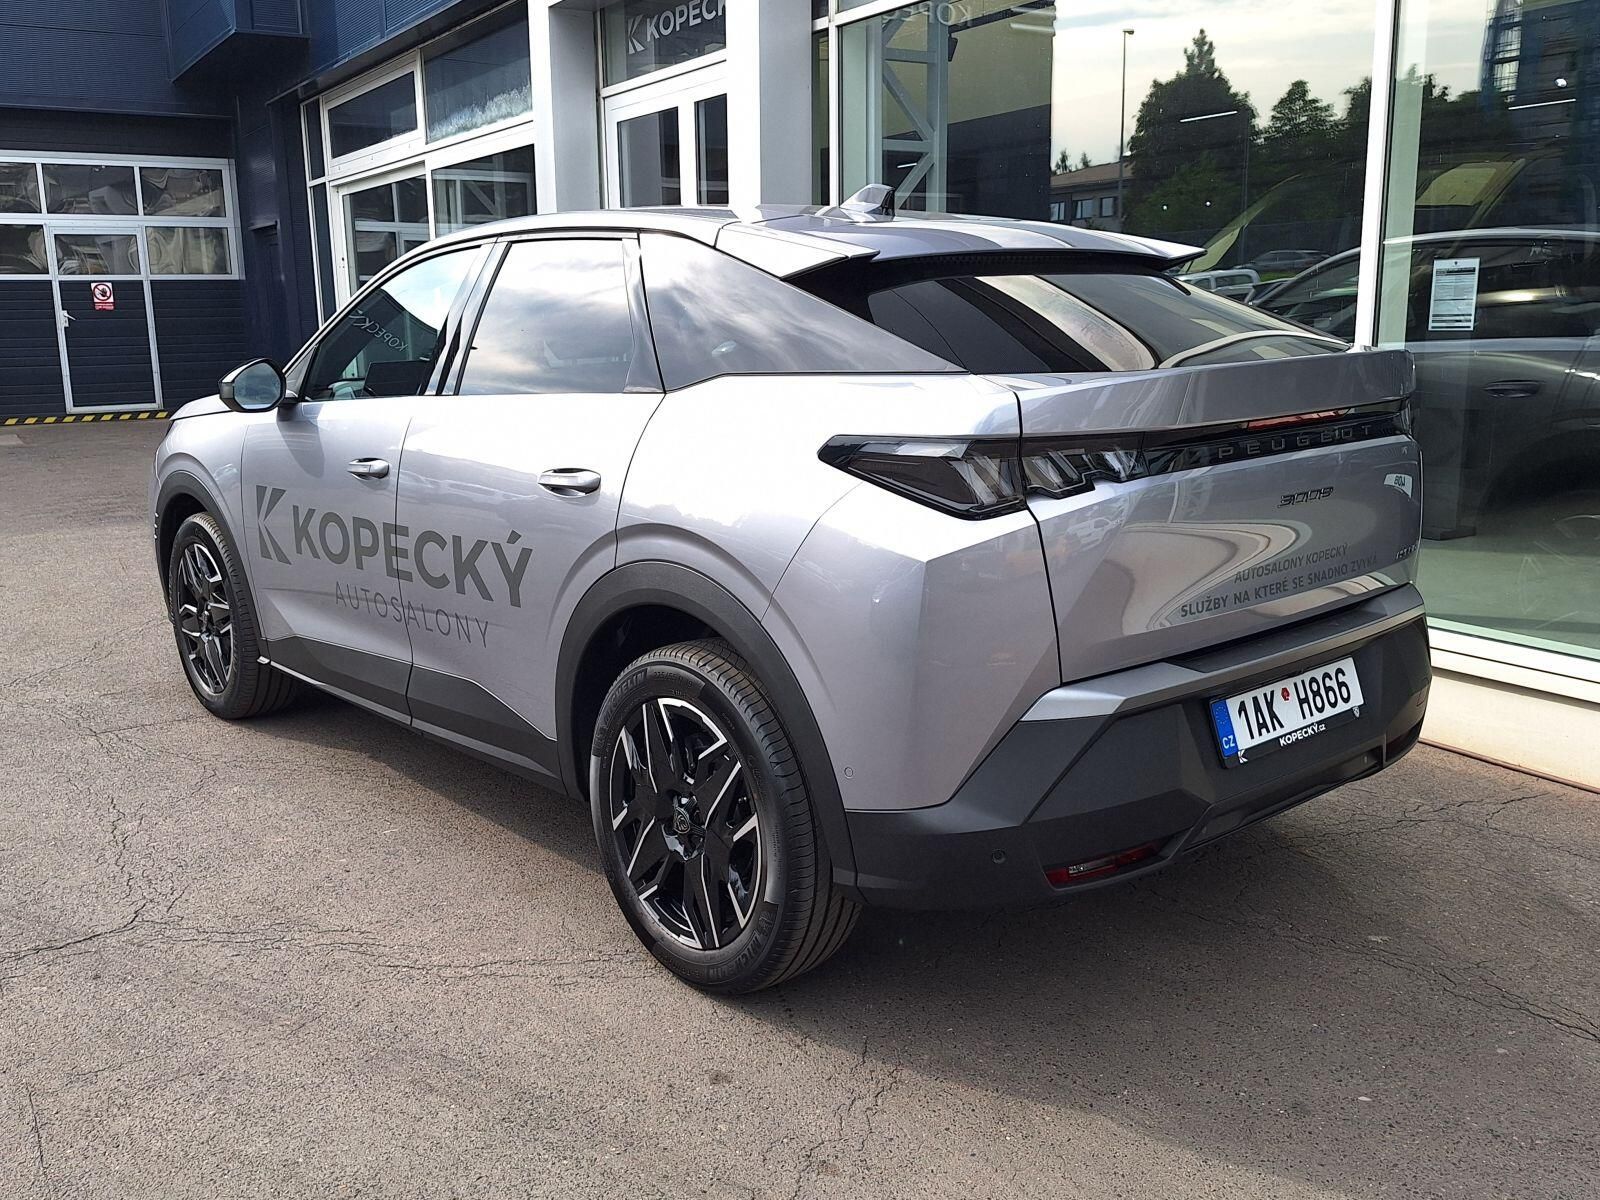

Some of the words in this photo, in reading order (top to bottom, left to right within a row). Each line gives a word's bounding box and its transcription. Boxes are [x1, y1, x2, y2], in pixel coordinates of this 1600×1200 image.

[1218, 424, 1372, 459] PEUGEOT
[292, 504, 533, 608] KOPECKÝ
[1234, 555, 1305, 584] AUTOSALONY
[335, 581, 489, 649] AUTOSALONY
[1180, 595, 1229, 618] SLUŽBY
[1233, 592, 1250, 605] NA
[1254, 577, 1289, 600] KTERÉ
[1292, 575, 1305, 589] SE
[1308, 564, 1348, 585] SNADNO
[1238, 690, 1284, 740] 1AK
[1294, 667, 1351, 720] H866
[1222, 736, 1236, 749] CZ
